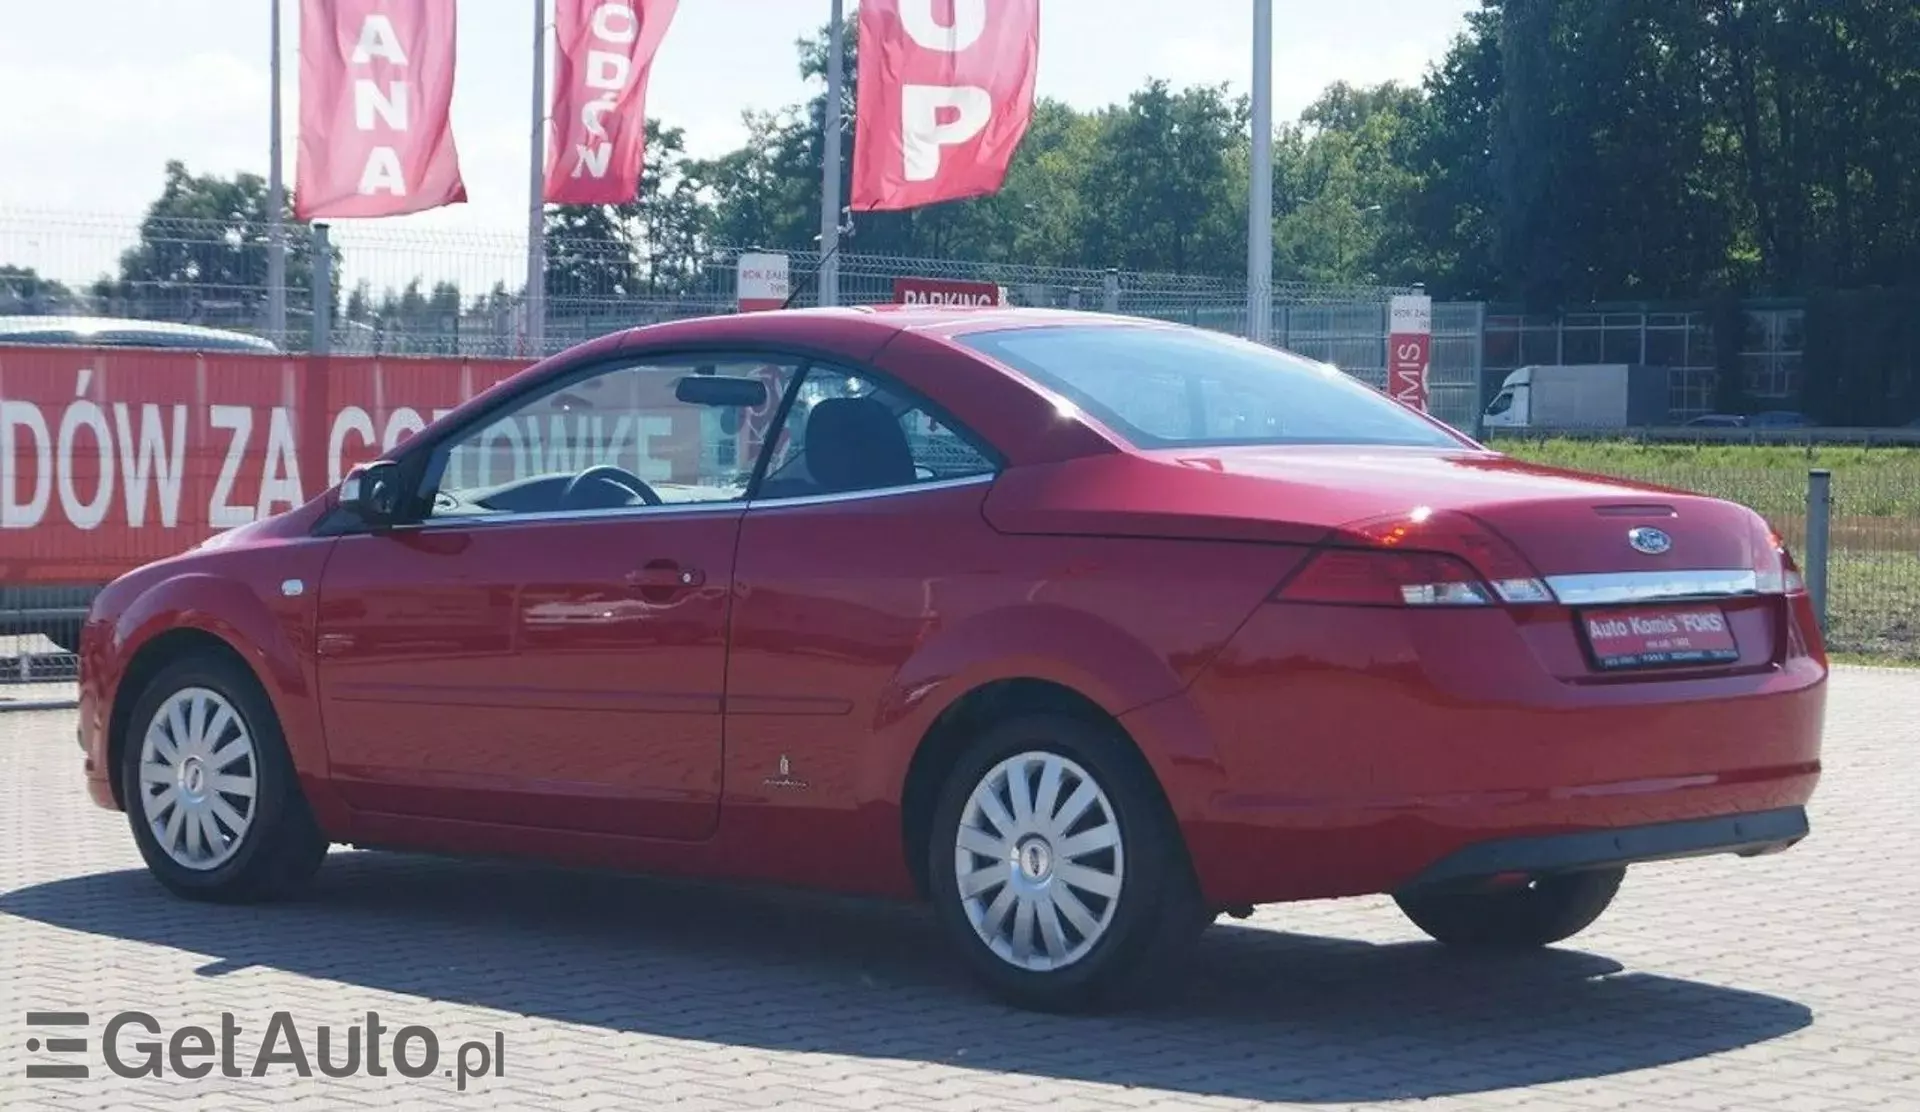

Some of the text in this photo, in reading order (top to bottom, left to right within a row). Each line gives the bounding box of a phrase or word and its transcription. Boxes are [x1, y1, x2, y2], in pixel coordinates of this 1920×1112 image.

[0, 369, 189, 530] DÓW
[208, 404, 305, 528] ZA
[1589, 620, 1628, 639] Auto
